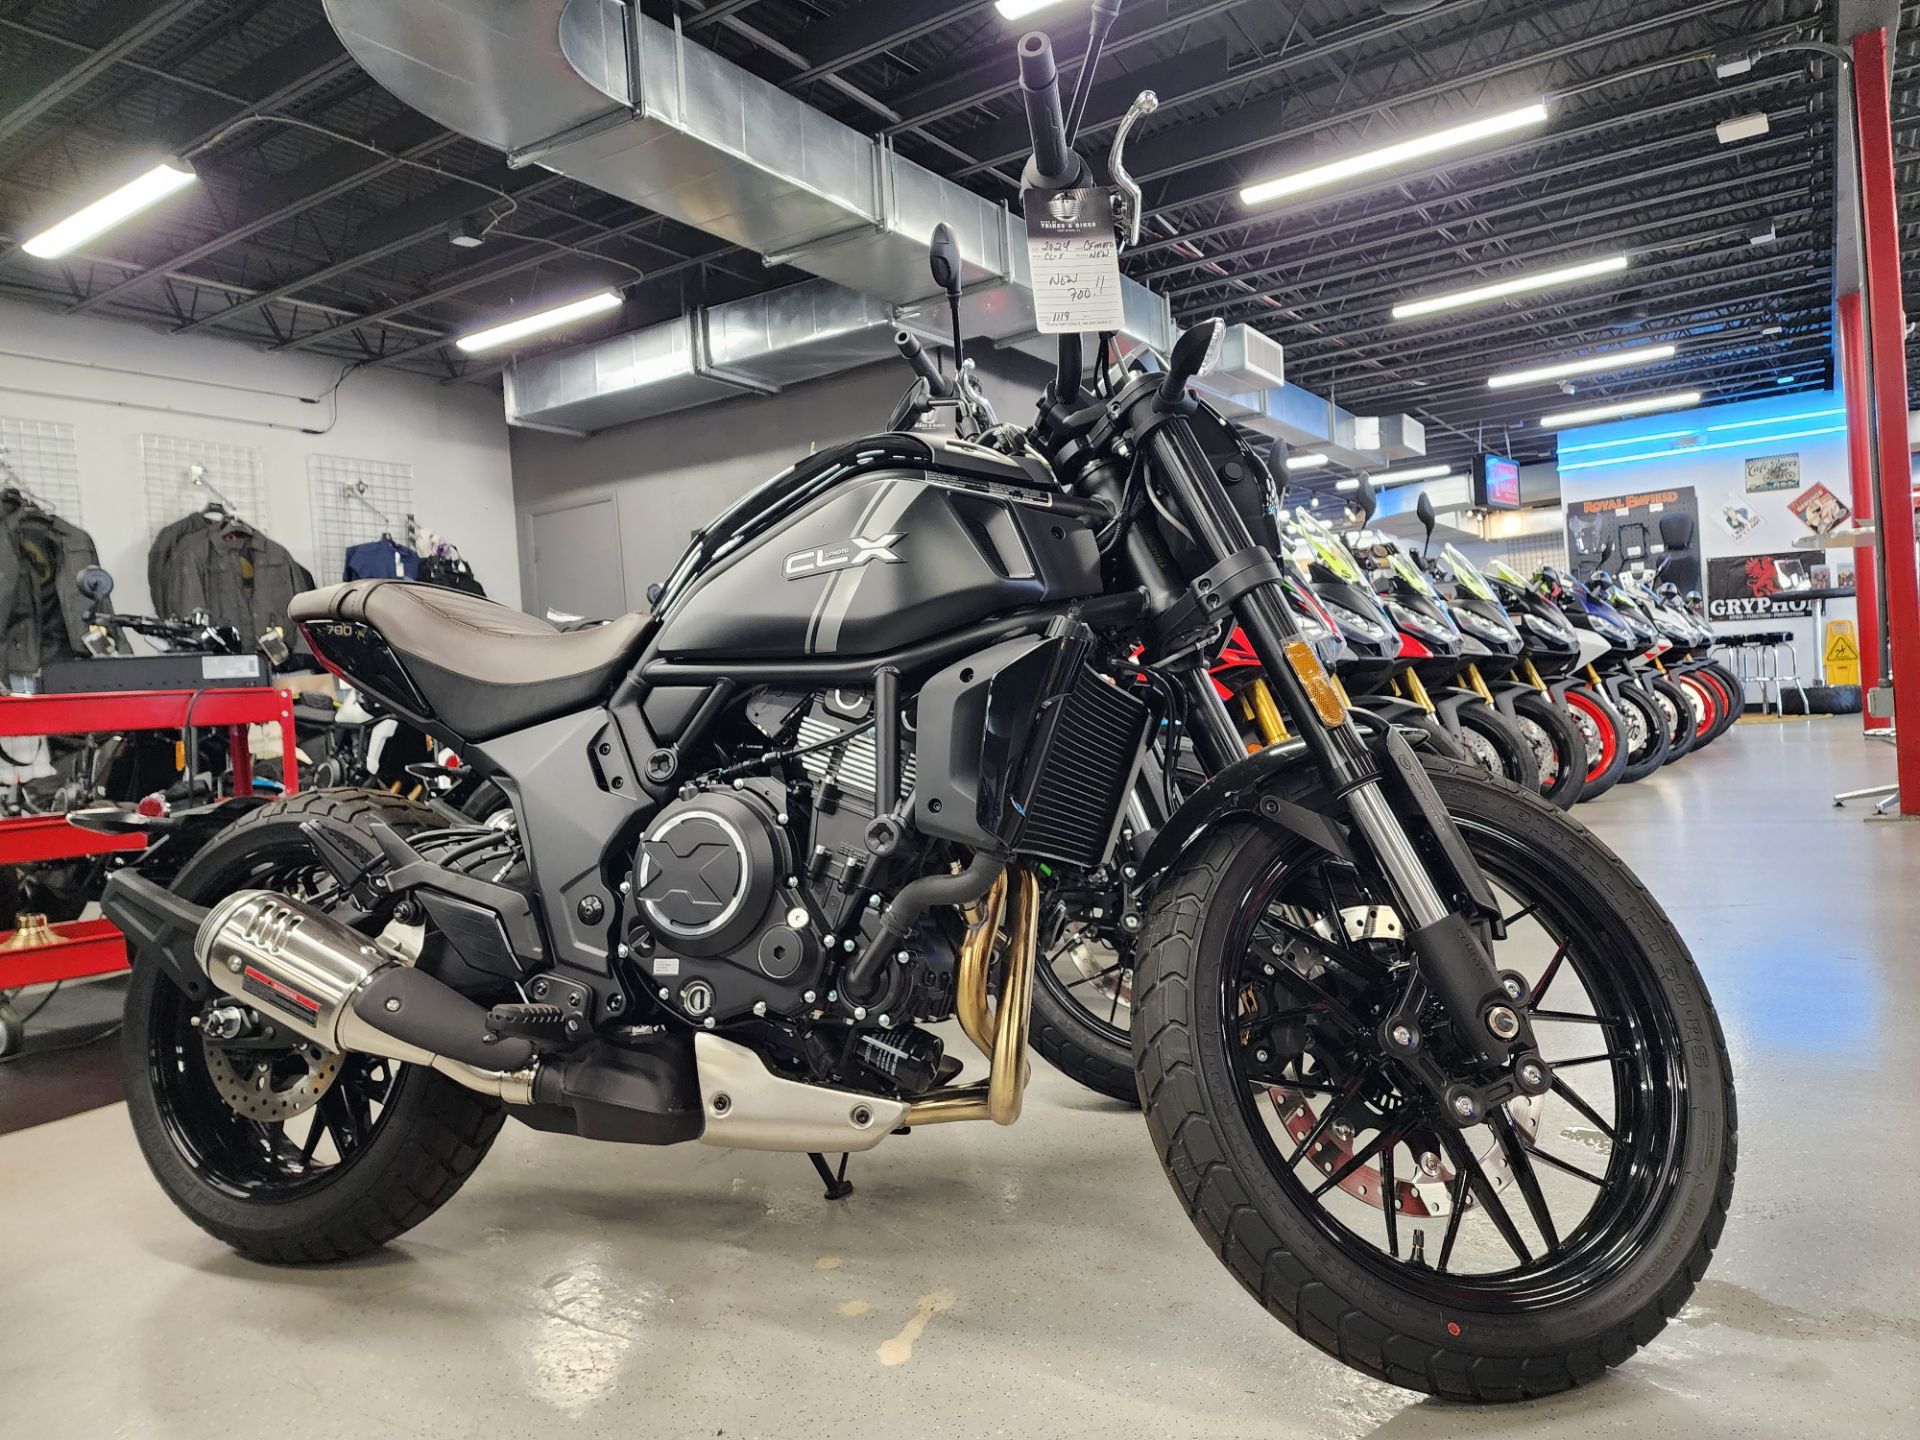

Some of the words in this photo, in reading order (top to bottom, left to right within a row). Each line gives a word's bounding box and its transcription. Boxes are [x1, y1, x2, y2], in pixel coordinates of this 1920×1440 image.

[1042, 240, 1070, 251] 2024
[1089, 249, 1109, 258] NEW
[1049, 272, 1078, 286] NEW
[1583, 498, 1622, 513] ROYAL
[1626, 491, 1679, 508] ENFIELD
